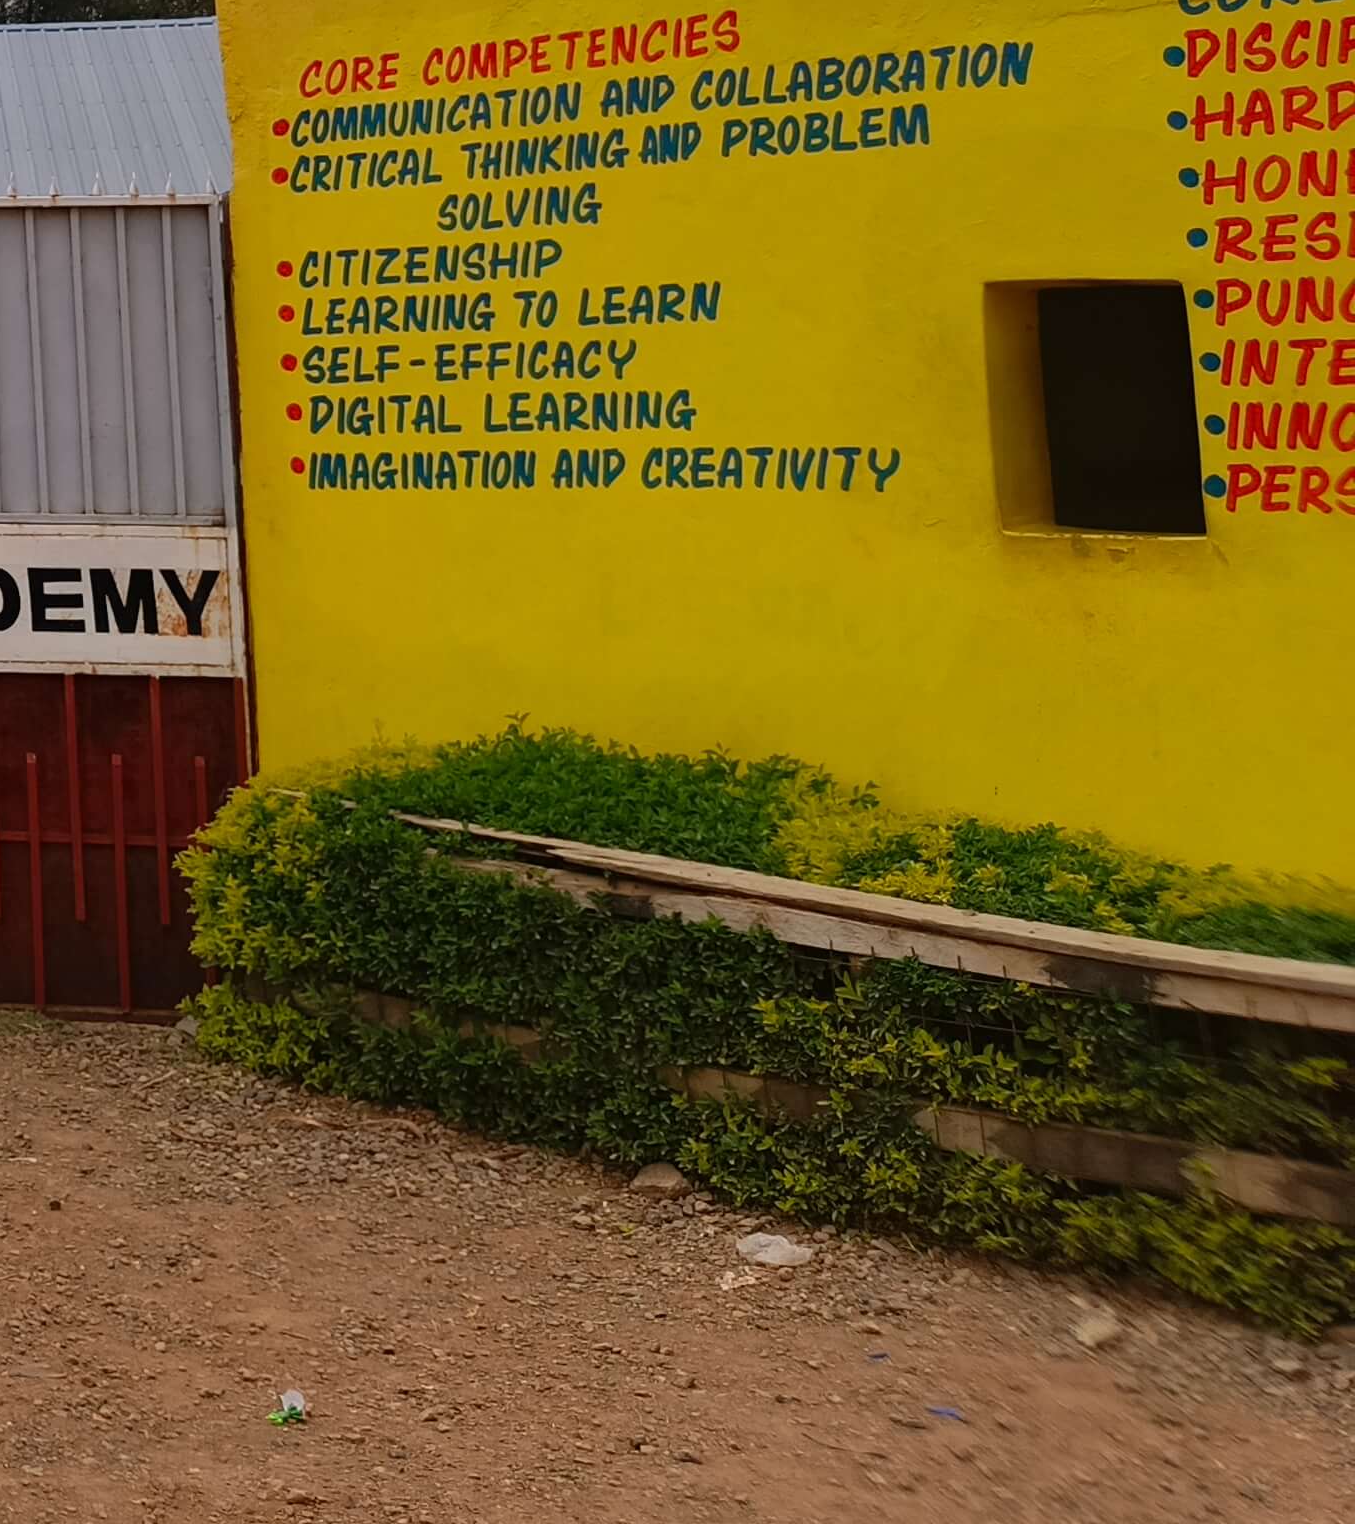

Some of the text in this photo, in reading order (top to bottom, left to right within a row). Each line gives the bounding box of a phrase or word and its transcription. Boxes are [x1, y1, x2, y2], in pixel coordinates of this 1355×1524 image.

[299, 9, 741, 99] CORE COMPETENCIES
[291, 41, 1034, 148] COMMUNICATION AND COLLABORATION
[291, 103, 931, 194] CRITICAL THINKING AND PROBLEM
[438, 182, 603, 232] SOLVING
[299, 238, 563, 289] CITIZENSHIP
[301, 282, 722, 337] LEARNING TO LEARN
[302, 340, 637, 385] SELF-EFFICACY
[310, 389, 697, 437] DIGITAL LEARNING
[309, 446, 901, 493] IMAGINATION AND CREATIVITY
